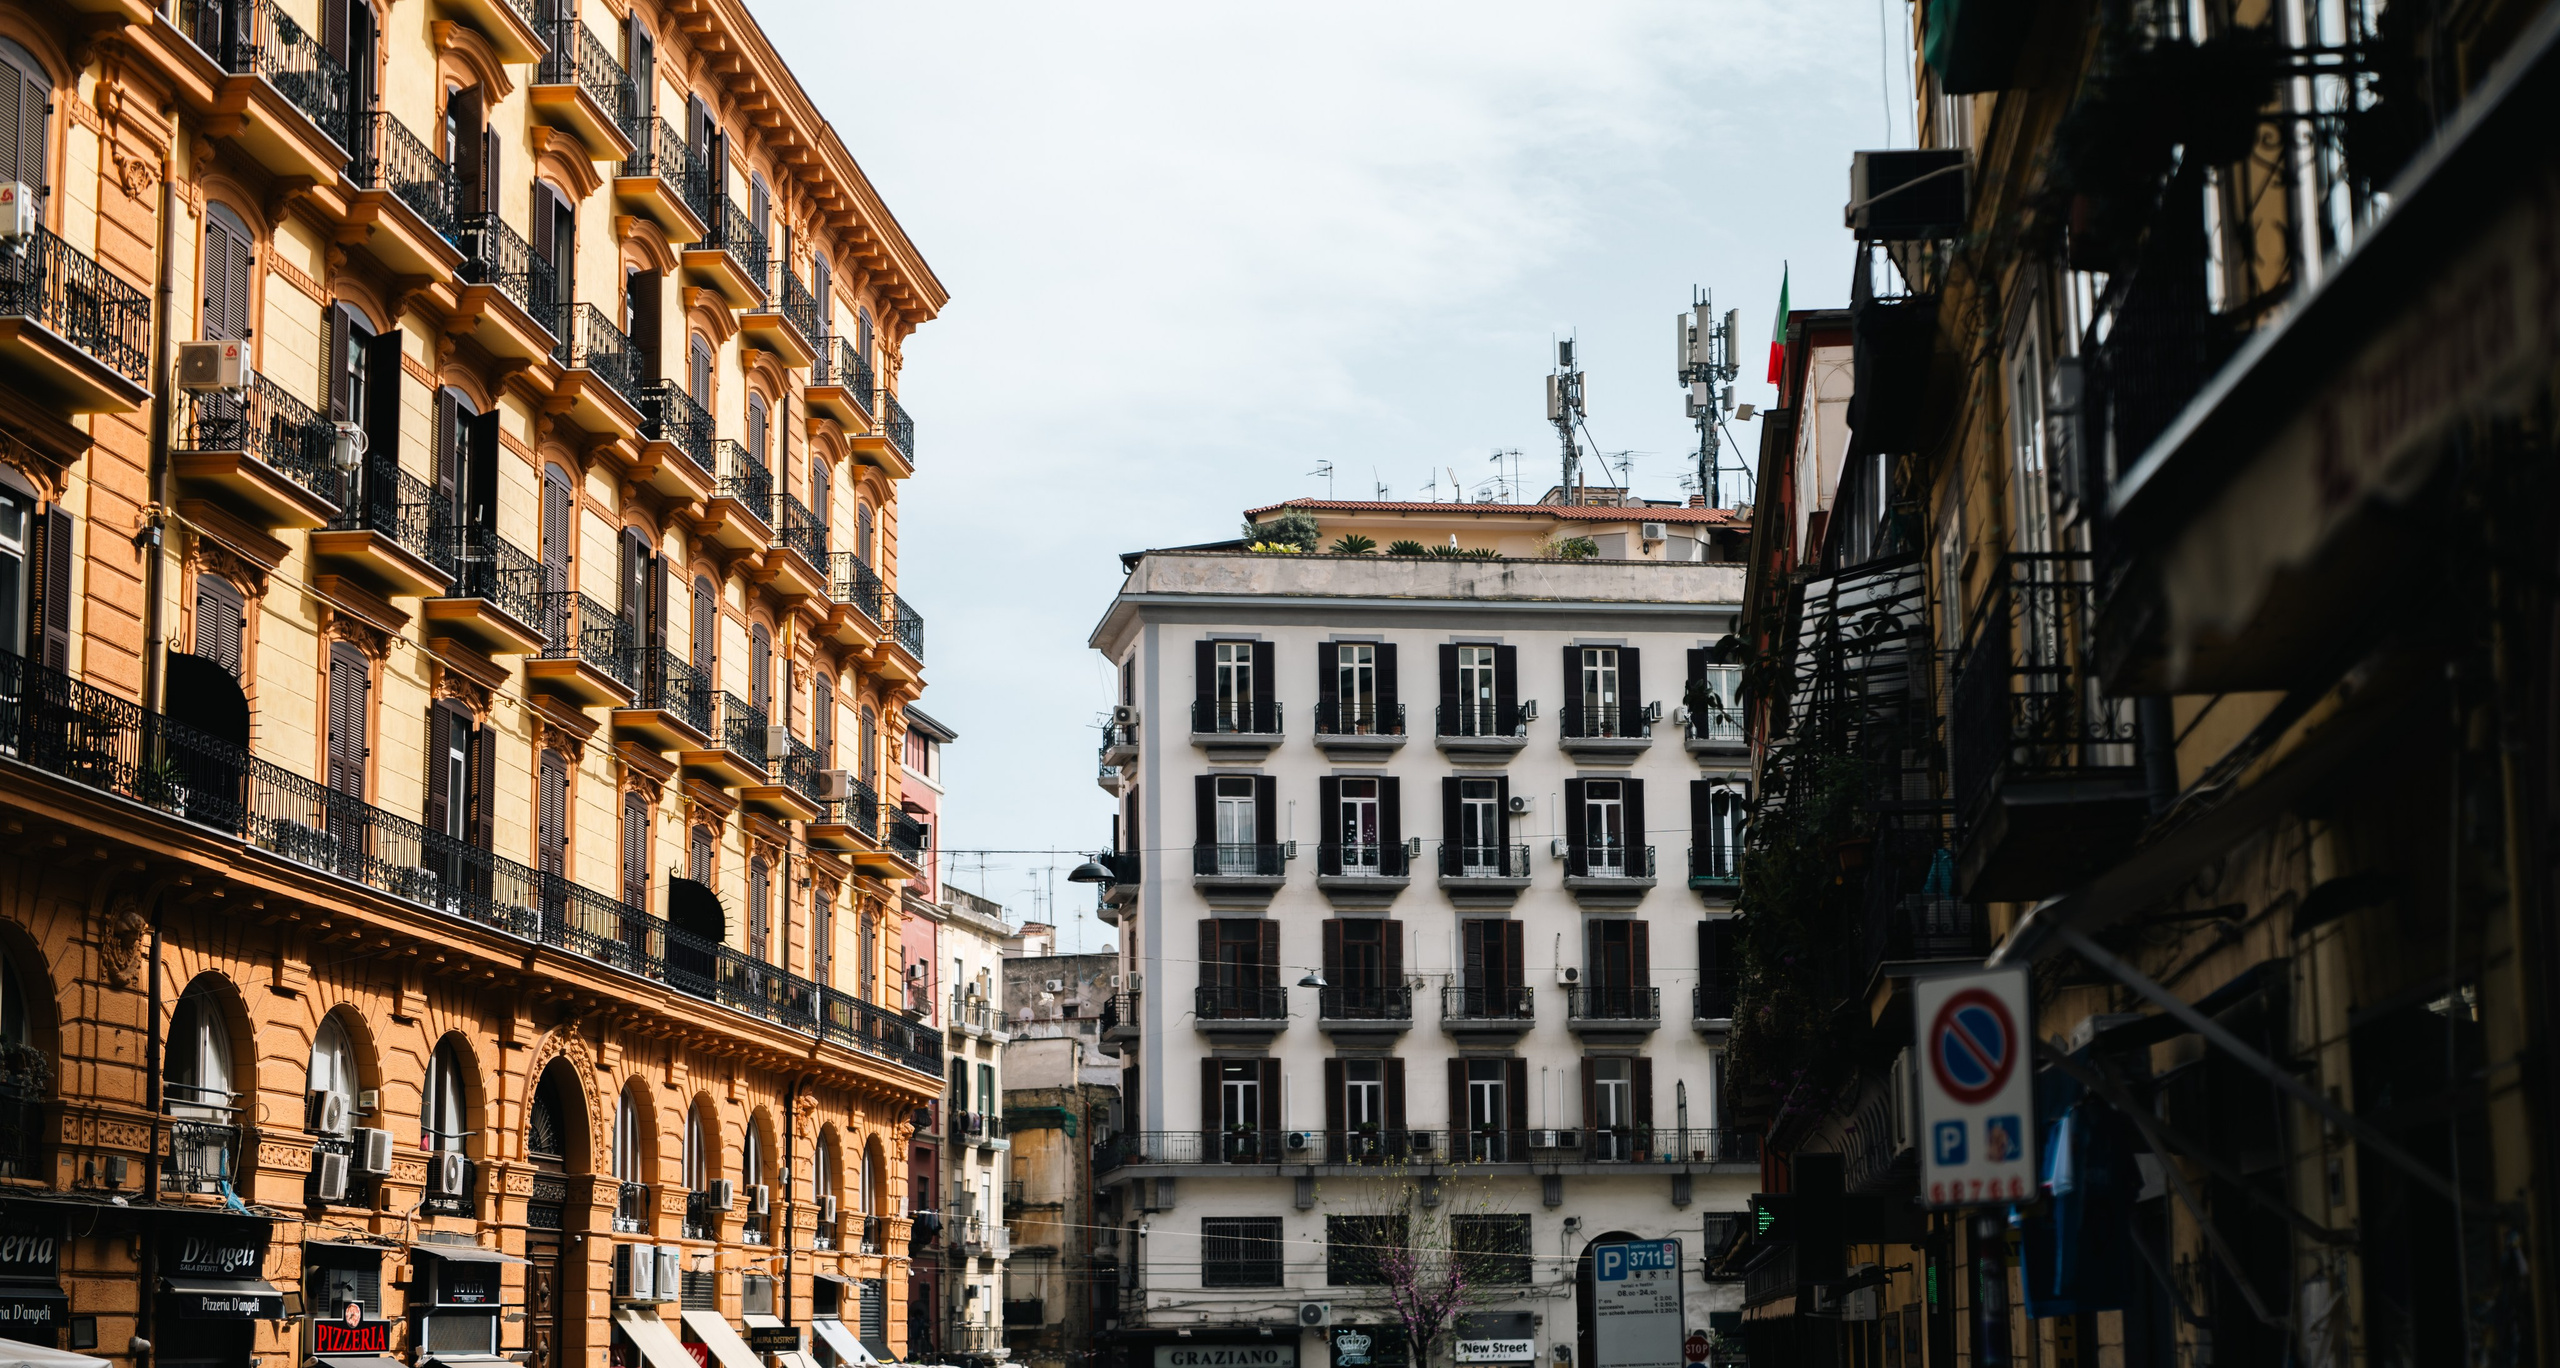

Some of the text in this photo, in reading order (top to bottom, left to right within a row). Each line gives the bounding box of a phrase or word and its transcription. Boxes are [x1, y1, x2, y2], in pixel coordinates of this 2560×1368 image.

[1940, 1127, 1961, 1159] P
[0, 1227, 54, 1264] eria
[181, 1236, 256, 1273] D'Angeli
[1604, 1251, 1621, 1277] P
[1630, 1250, 1661, 1266] 3711
[13, 1303, 51, 1325] D'angeli
[202, 1296, 260, 1316] Pizzeria D'angeli
[316, 1324, 386, 1351] PIZZERIA
[1463, 1342, 1528, 1353] New Street
[1171, 1350, 1278, 1366] GRAZIANO
[1685, 1344, 1708, 1354] STOP
